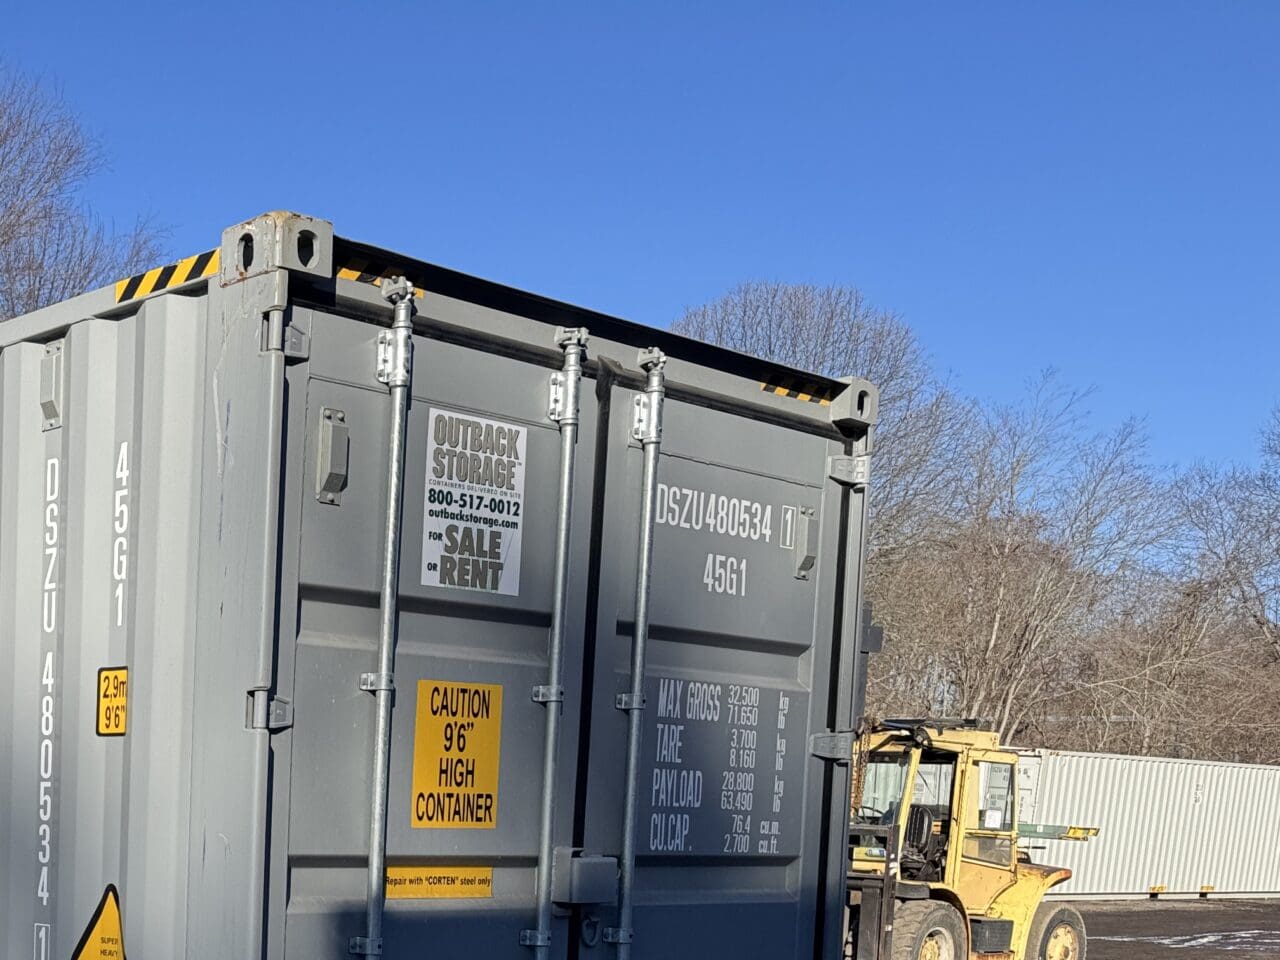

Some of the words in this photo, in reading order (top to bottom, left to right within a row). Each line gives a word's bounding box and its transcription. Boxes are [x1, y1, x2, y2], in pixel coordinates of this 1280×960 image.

[433, 413, 520, 461] OUTBACK
[432, 447, 516, 491] STORAGE
[428, 479, 466, 490] CONTAINERS
[467, 485, 498, 495] DELIVERED
[428, 488, 520, 517] 800-517-0012
[113, 441, 129, 627] 45G1
[428, 508, 519, 530] outbackstorage.com
[43, 458, 59, 633] DSZU
[428, 531, 443, 542] FOR
[444, 524, 502, 560] SALE
[427, 562, 438, 572] OR
[439, 555, 503, 591] RENT
[703, 553, 747, 597] 45G1
[430, 686, 491, 719] CAUTION
[657, 678, 683, 719] MAX
[686, 682, 722, 722] GROSS
[779, 691, 790, 713] kg
[777, 711, 785, 729] lb
[656, 723, 685, 763] TARE
[776, 733, 786, 755] kg
[37, 651, 54, 906] 480534
[438, 757, 476, 788] HIGH
[776, 753, 783, 771] lb
[651, 769, 703, 808] PAYLOAD
[774, 775, 784, 797] kg
[772, 794, 780, 813] lb
[416, 792, 493, 823] CONTAINER
[731, 814, 751, 834] 76.4
[385, 876, 407, 887] Repair
[408, 876, 423, 885] with
[425, 876, 459, 885] "CORTEN"
[460, 876, 476, 886] steel
[477, 877, 492, 888] only
